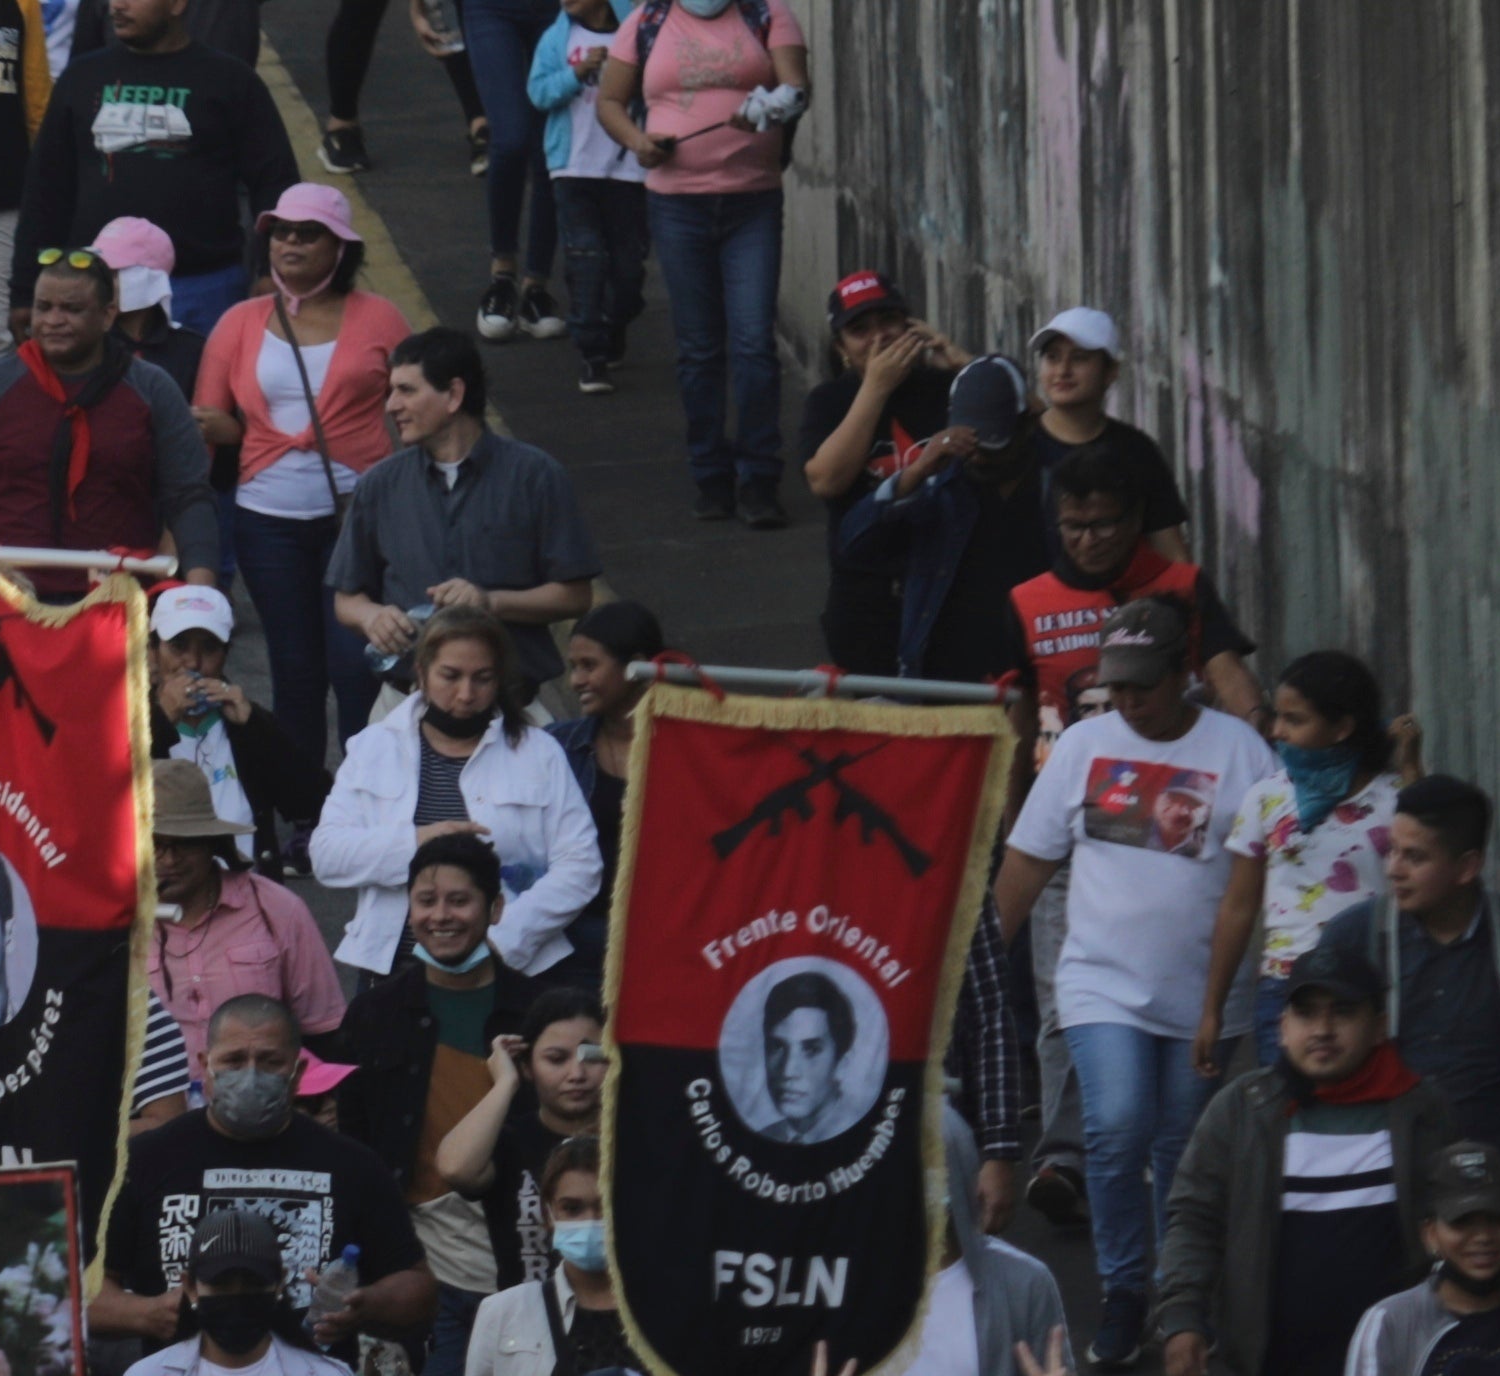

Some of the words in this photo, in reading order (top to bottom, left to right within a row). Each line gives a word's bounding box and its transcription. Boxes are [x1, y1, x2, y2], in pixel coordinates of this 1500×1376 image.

[701, 910, 798, 973] Frente
[804, 903, 914, 990] Oriental
[683, 1076, 732, 1167] Carlos
[728, 1157, 827, 1204] Roberto
[827, 1085, 908, 1195] Huembes
[712, 1248, 850, 1309] FSLN
[738, 1324, 784, 1344] 1979
